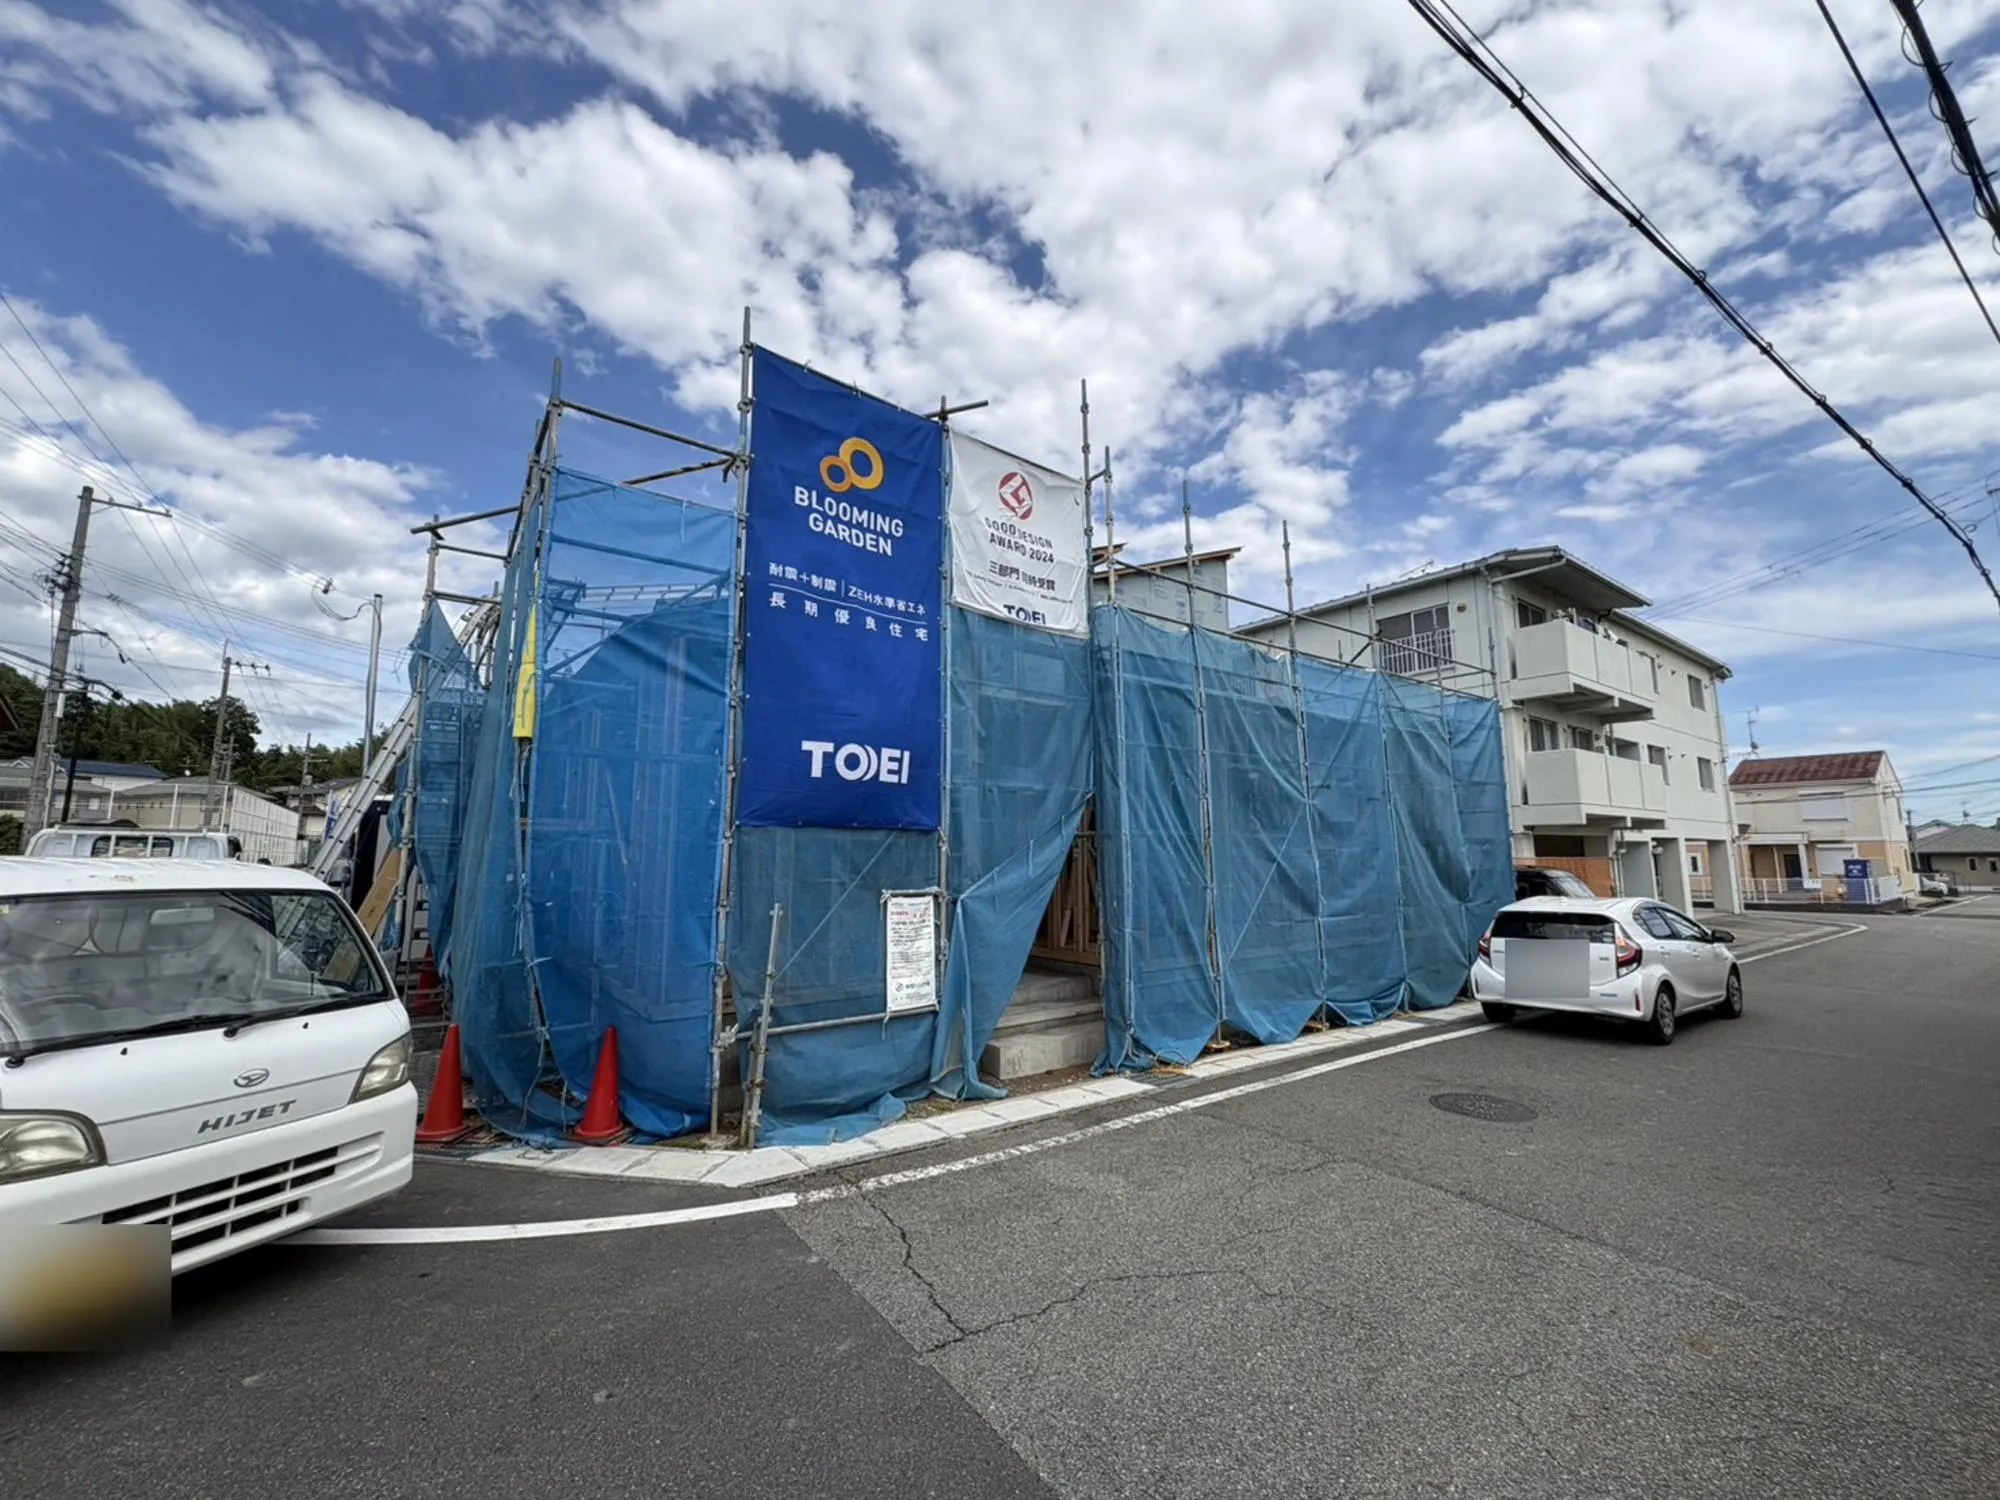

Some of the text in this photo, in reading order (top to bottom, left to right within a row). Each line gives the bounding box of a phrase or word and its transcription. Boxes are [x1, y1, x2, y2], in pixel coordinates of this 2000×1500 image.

[794, 485, 904, 537] BLOOMING
[808, 513, 892, 556] GARDEN
[989, 532, 1054, 564] AWARD 2024
[769, 591, 929, 642] 長期優良住宅
[197, 1099, 297, 1134] HIJET
